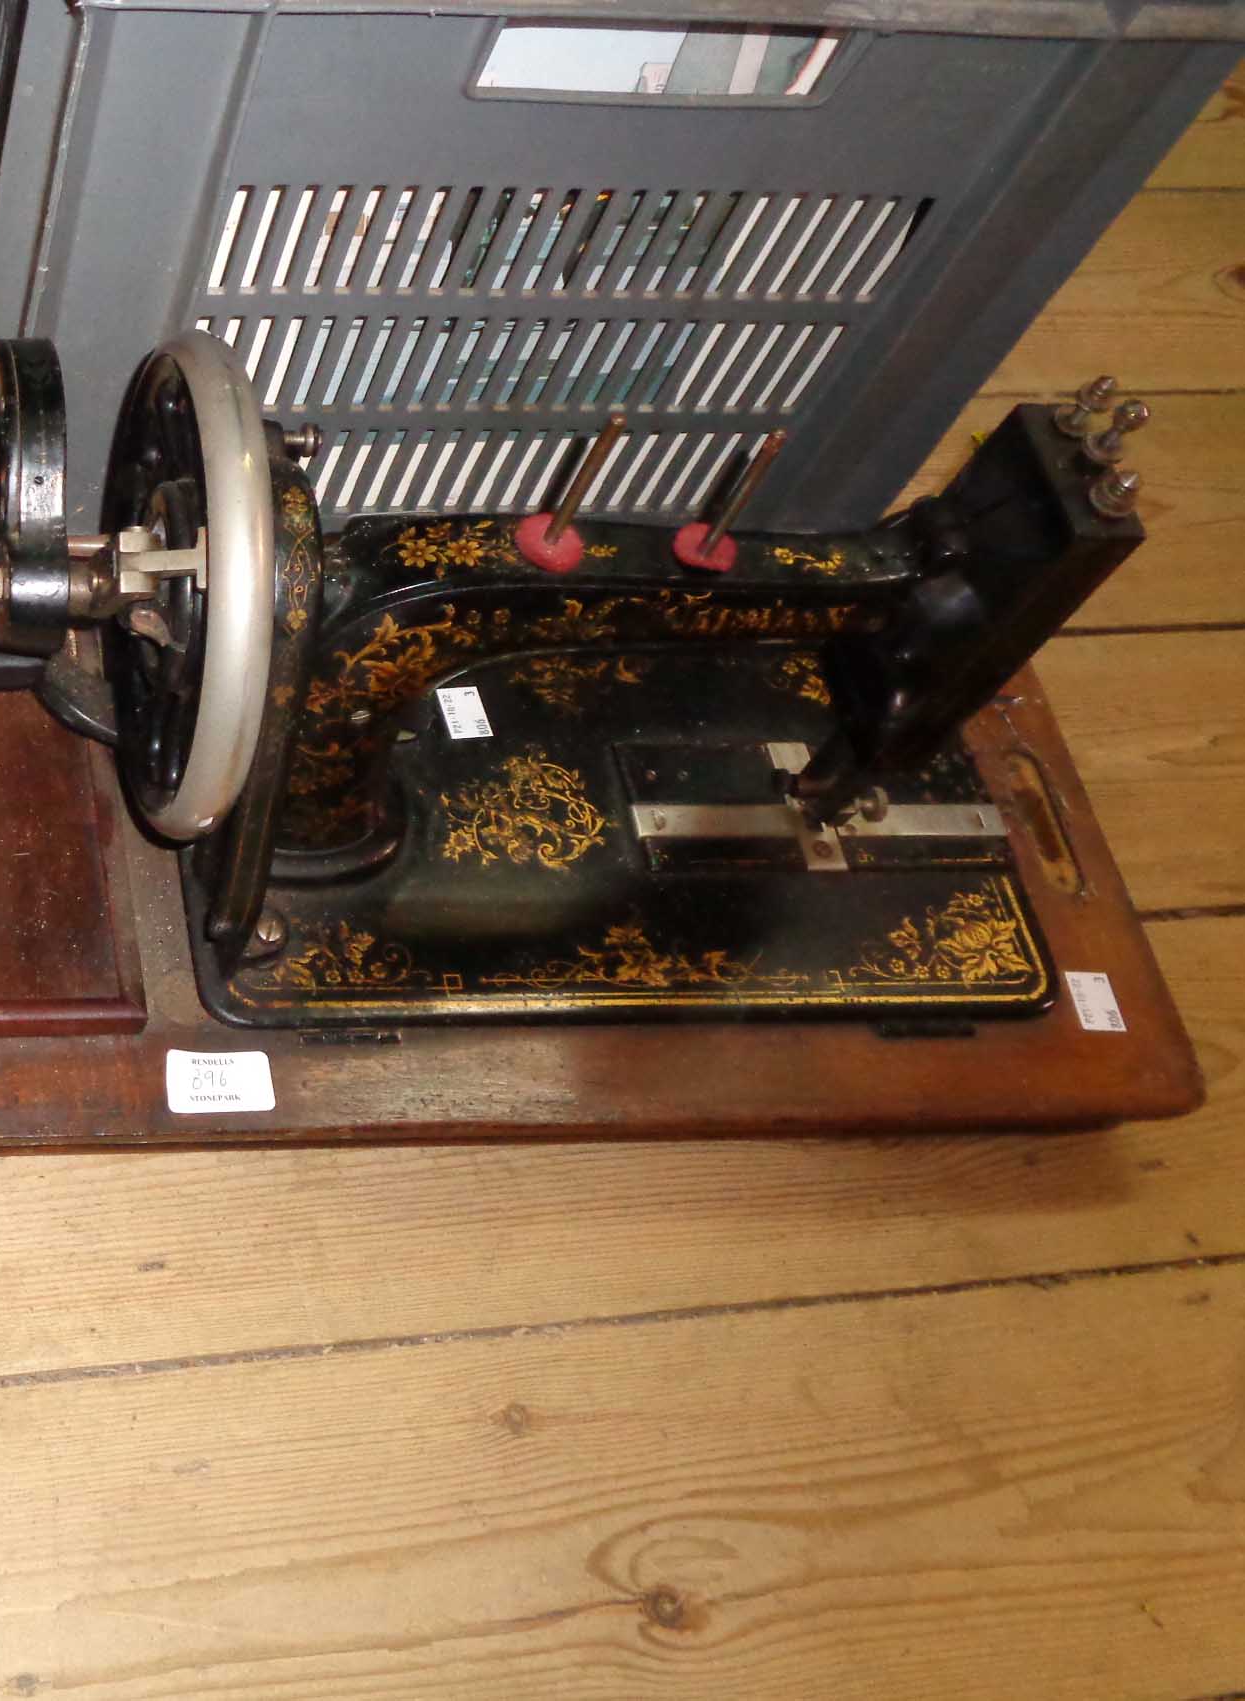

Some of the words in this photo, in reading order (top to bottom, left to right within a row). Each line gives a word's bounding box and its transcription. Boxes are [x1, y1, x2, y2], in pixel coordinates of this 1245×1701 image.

[474, 718, 490, 735] 806
[191, 1057, 235, 1066] RENDELLS
[189, 1093, 242, 1102] STONEPARK
